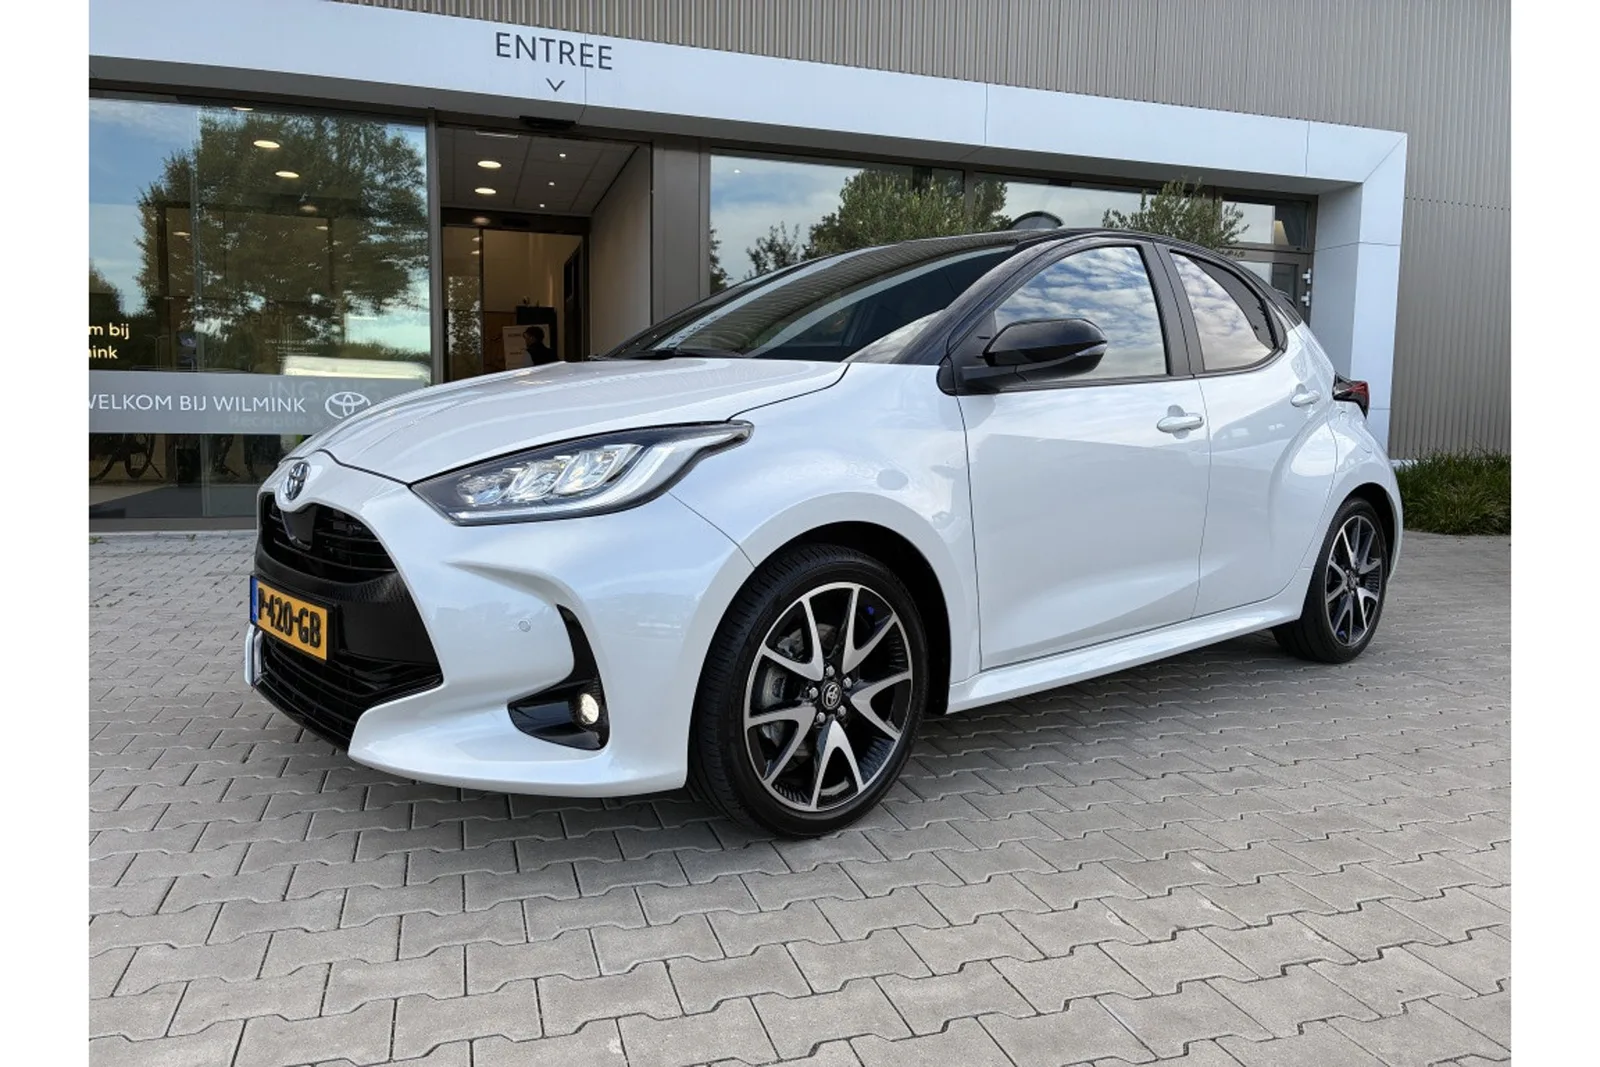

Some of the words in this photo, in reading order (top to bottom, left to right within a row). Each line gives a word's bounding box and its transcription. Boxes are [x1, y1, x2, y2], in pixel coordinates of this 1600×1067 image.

[495, 31, 613, 70] ENTREE
[109, 321, 130, 340] bij
[179, 395, 207, 411] BIJ
[212, 396, 307, 413] WILMINK
